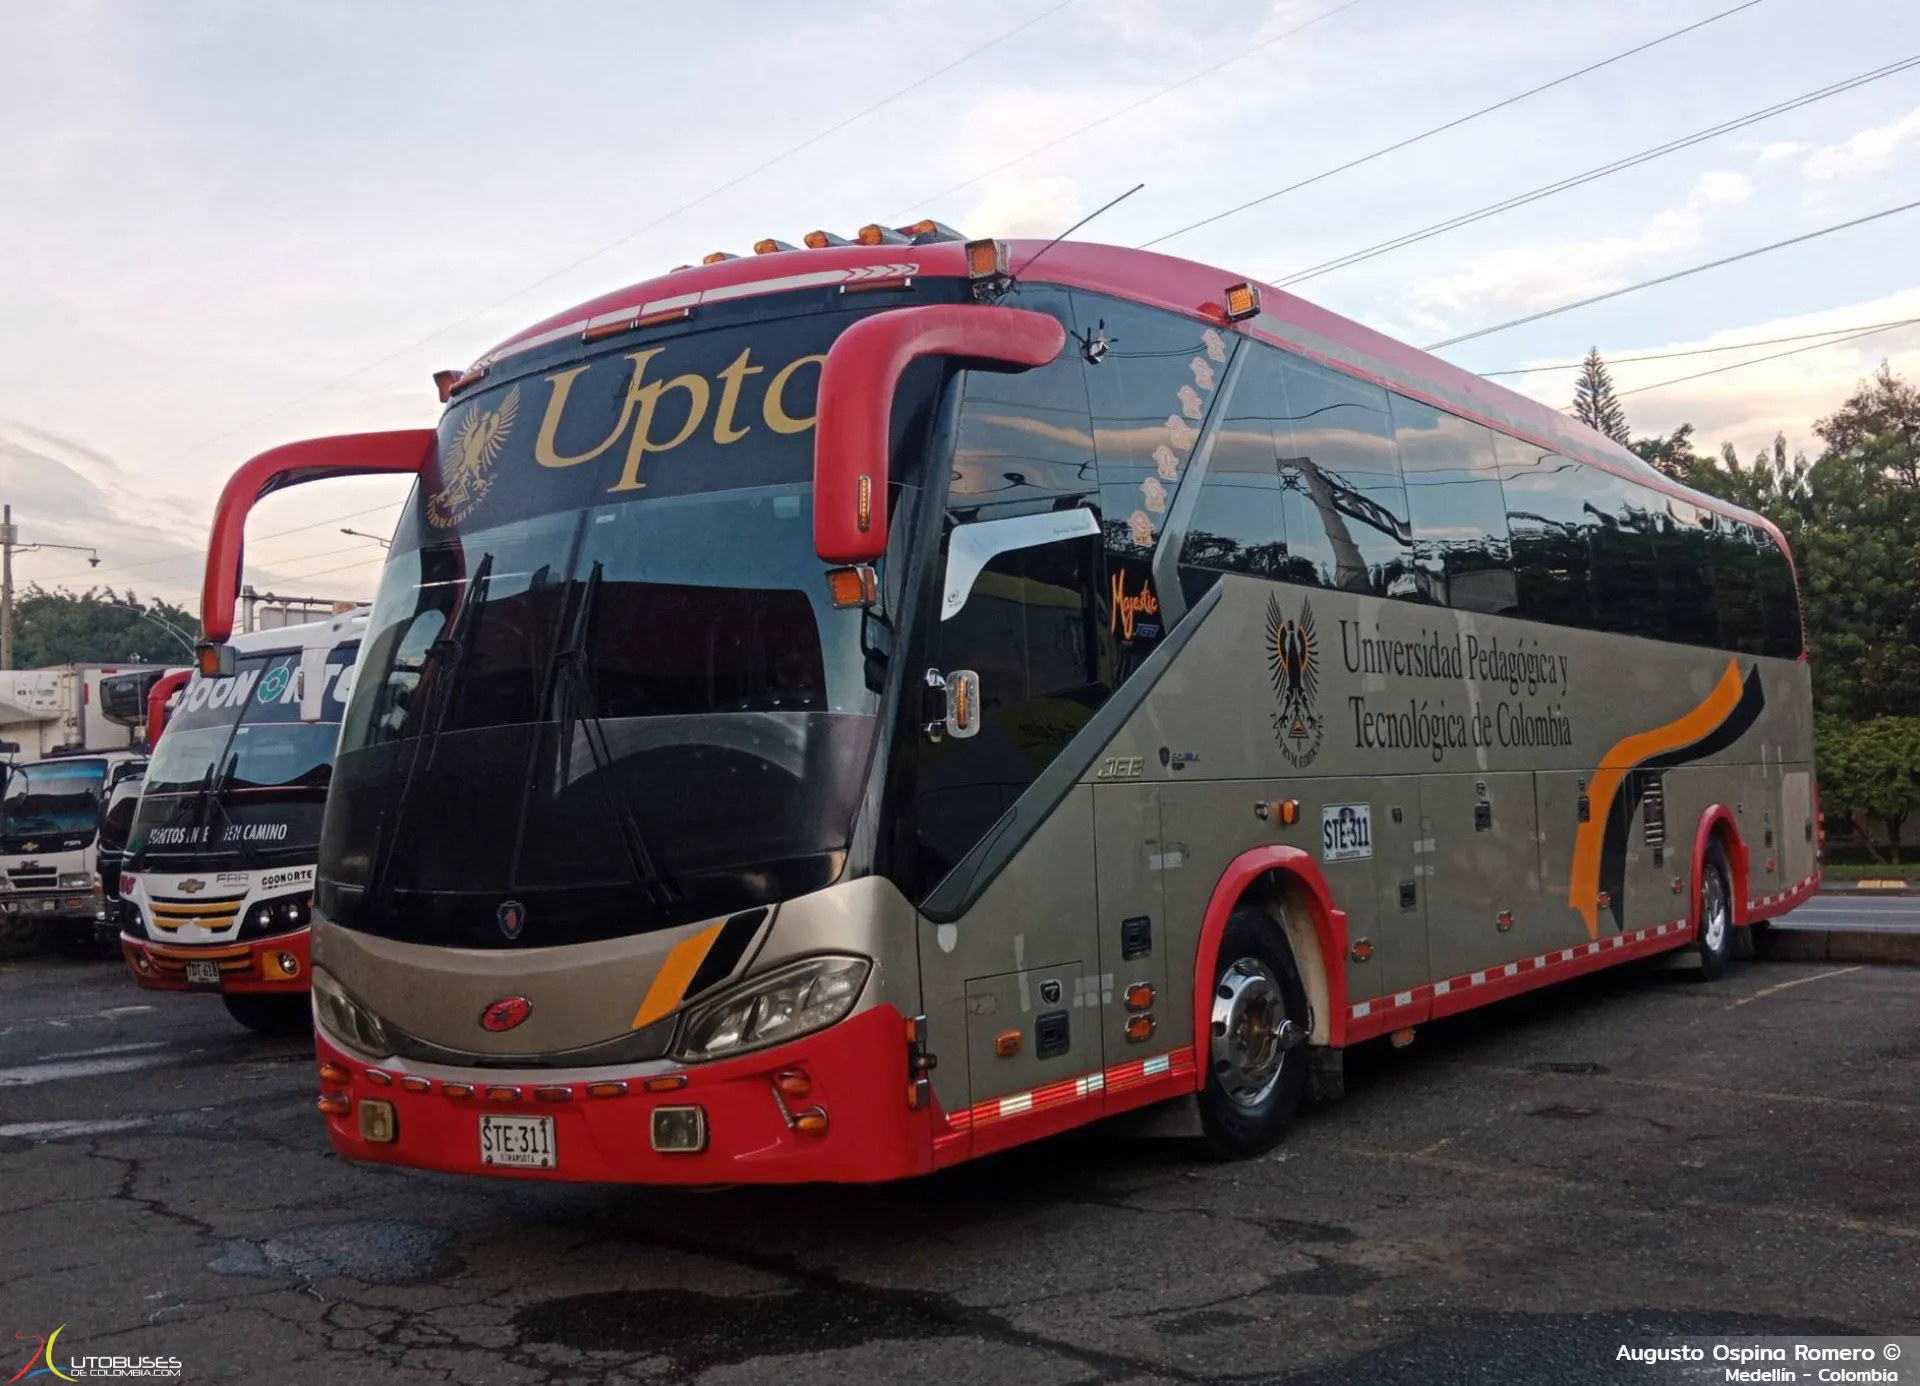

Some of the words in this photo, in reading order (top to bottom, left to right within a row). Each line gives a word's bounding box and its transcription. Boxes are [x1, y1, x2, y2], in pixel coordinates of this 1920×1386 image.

[1111, 569, 1158, 640] Majestic
[1338, 620, 1463, 679] Universidad
[1466, 635, 1557, 696] Pedagógica
[1558, 654, 1568, 696] y
[1348, 696, 1467, 763] Tecnológica
[1472, 702, 1492, 748] de
[1496, 702, 1572, 748] Colombia
[243, 824, 287, 841] CAMINO
[262, 869, 313, 886] COONORTE
